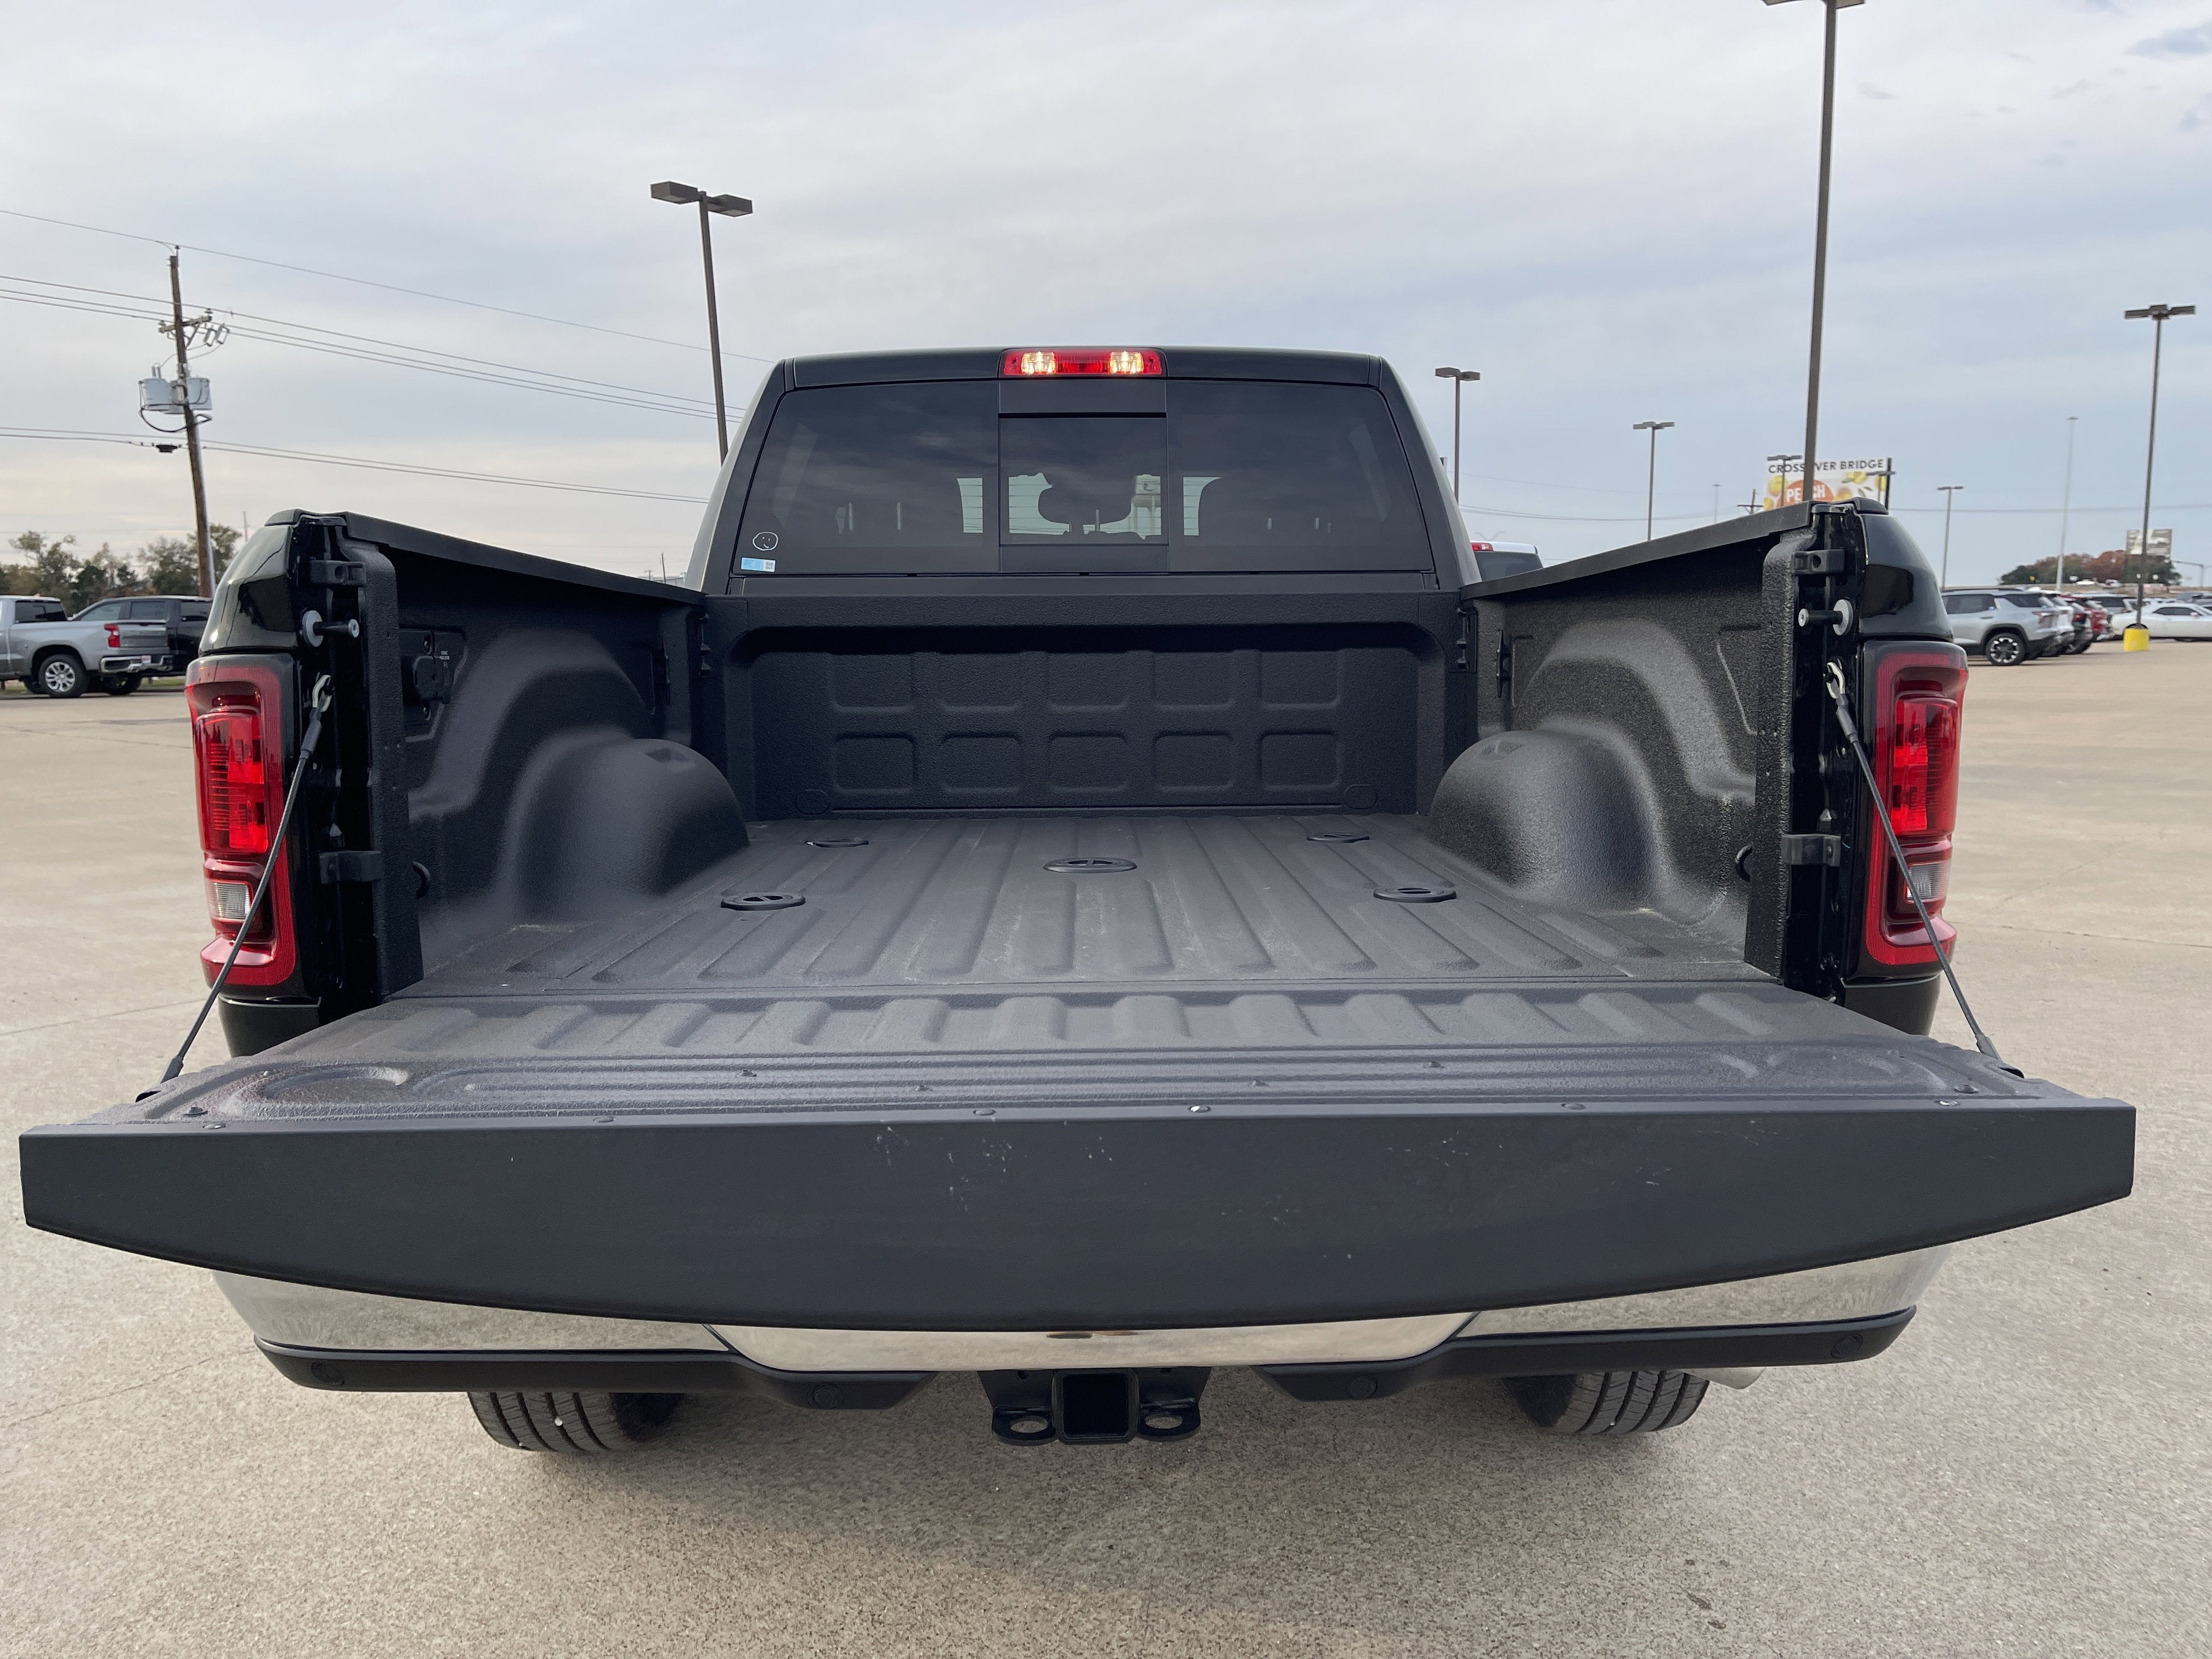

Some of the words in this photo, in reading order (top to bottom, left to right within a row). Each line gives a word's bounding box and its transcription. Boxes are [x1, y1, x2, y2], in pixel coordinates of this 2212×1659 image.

[1768, 461, 1836, 473] CROSSVER
[1840, 459, 1883, 470] BRIDGE
[1786, 484, 1826, 503] PECH
